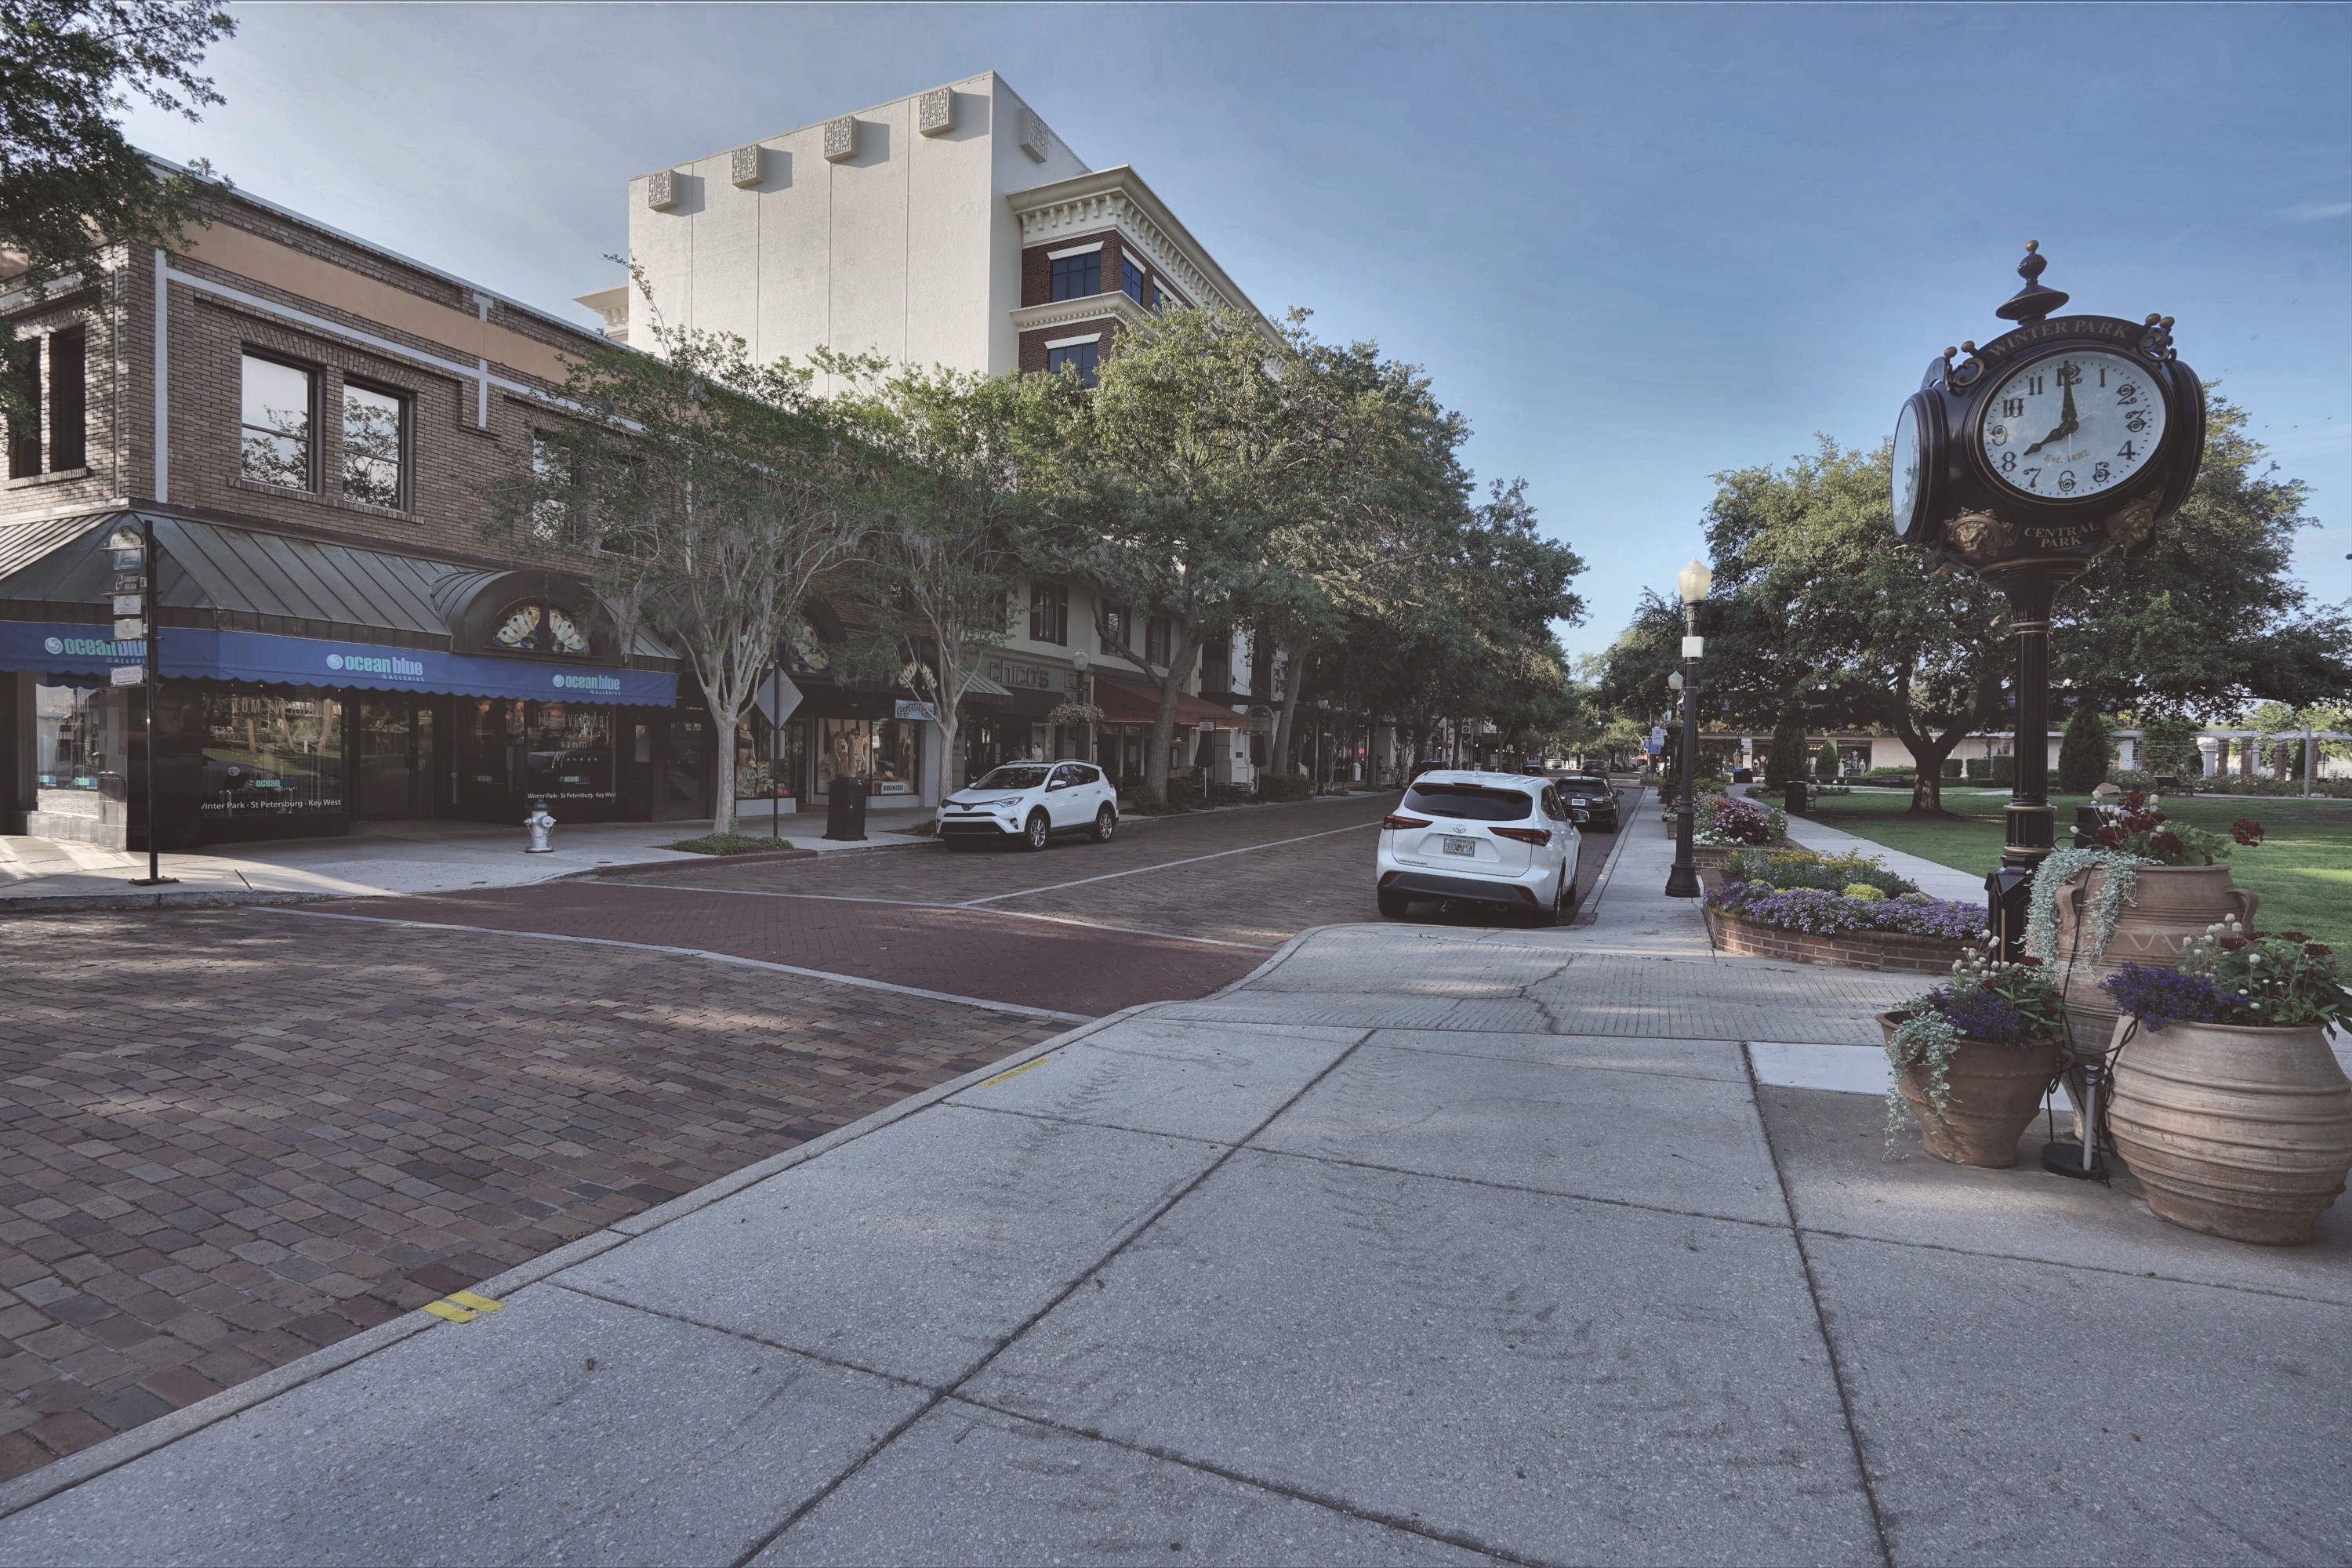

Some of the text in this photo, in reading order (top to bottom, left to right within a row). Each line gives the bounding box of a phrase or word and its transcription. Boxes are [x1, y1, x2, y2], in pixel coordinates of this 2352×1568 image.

[1988, 320, 2132, 357] WINTER PARK
[2028, 376, 2043, 396] 11
[2115, 383, 2137, 405] 2
[2125, 409, 2147, 433] 3
[1991, 425, 2010, 446] 9
[2117, 441, 2136, 460] 4
[2001, 452, 2017, 472] 8
[2092, 461, 2111, 483] 5
[2024, 467, 2042, 488] 7
[2058, 470, 2077, 492] 6
[2024, 521, 2100, 538] CENTRAL
[2041, 535, 2083, 548] PARK
[382, 673, 425, 682] GALLERIES
[260, 800, 303, 809] Petersburg
